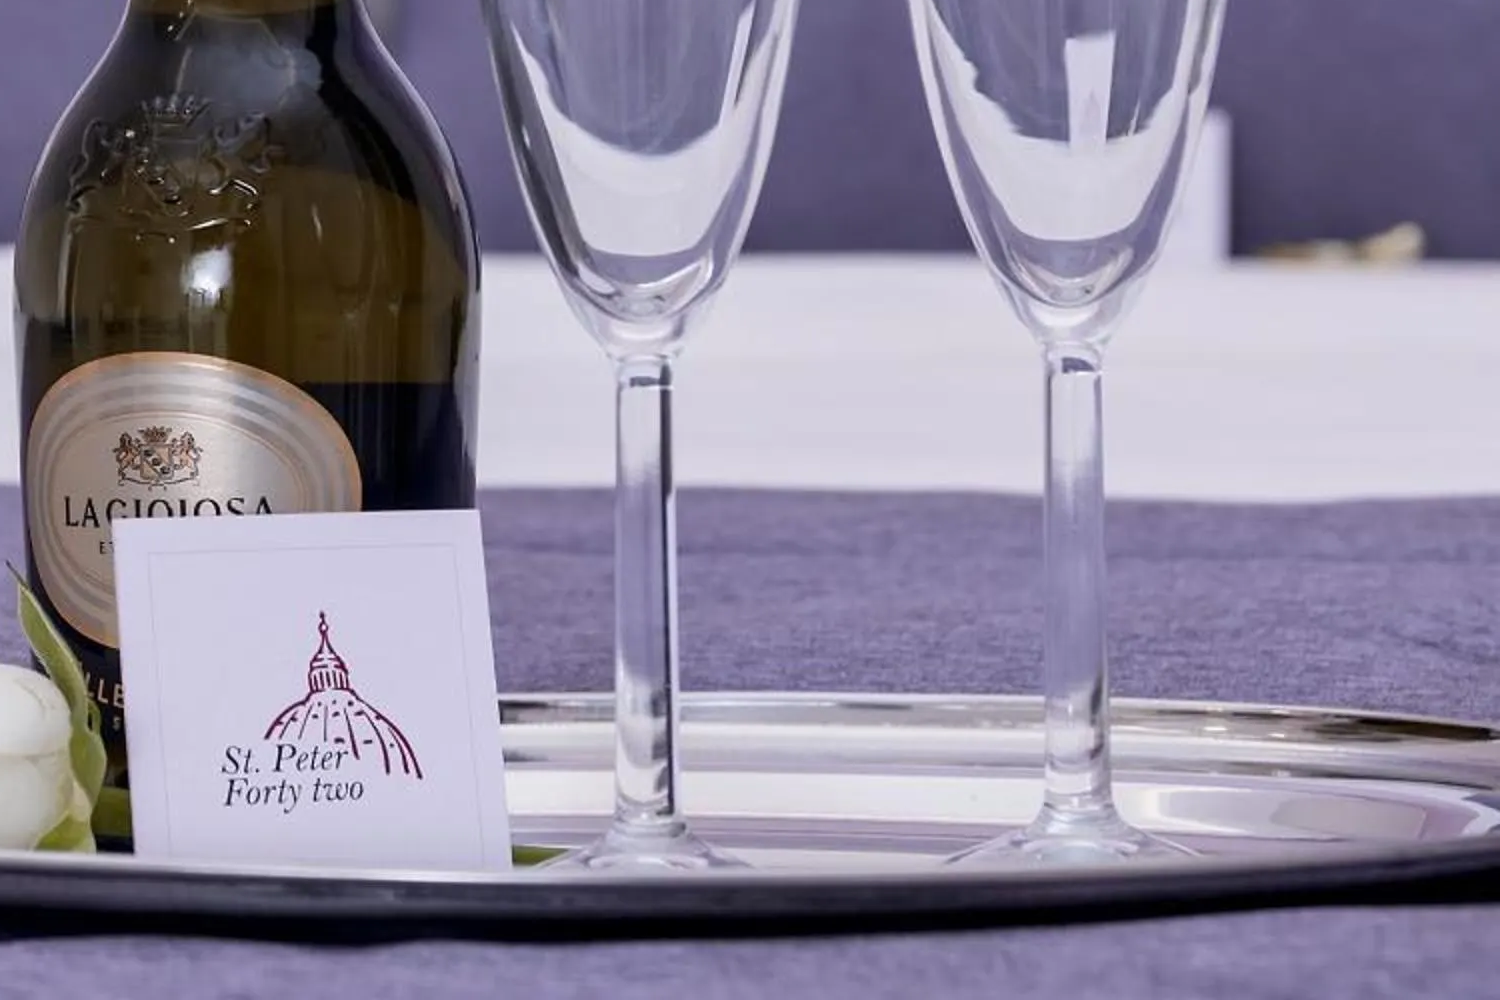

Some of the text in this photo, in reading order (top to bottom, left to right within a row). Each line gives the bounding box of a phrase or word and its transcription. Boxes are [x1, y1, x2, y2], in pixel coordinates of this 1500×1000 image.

[221, 743, 349, 775] St. Peter
[224, 777, 365, 815] Forty two
